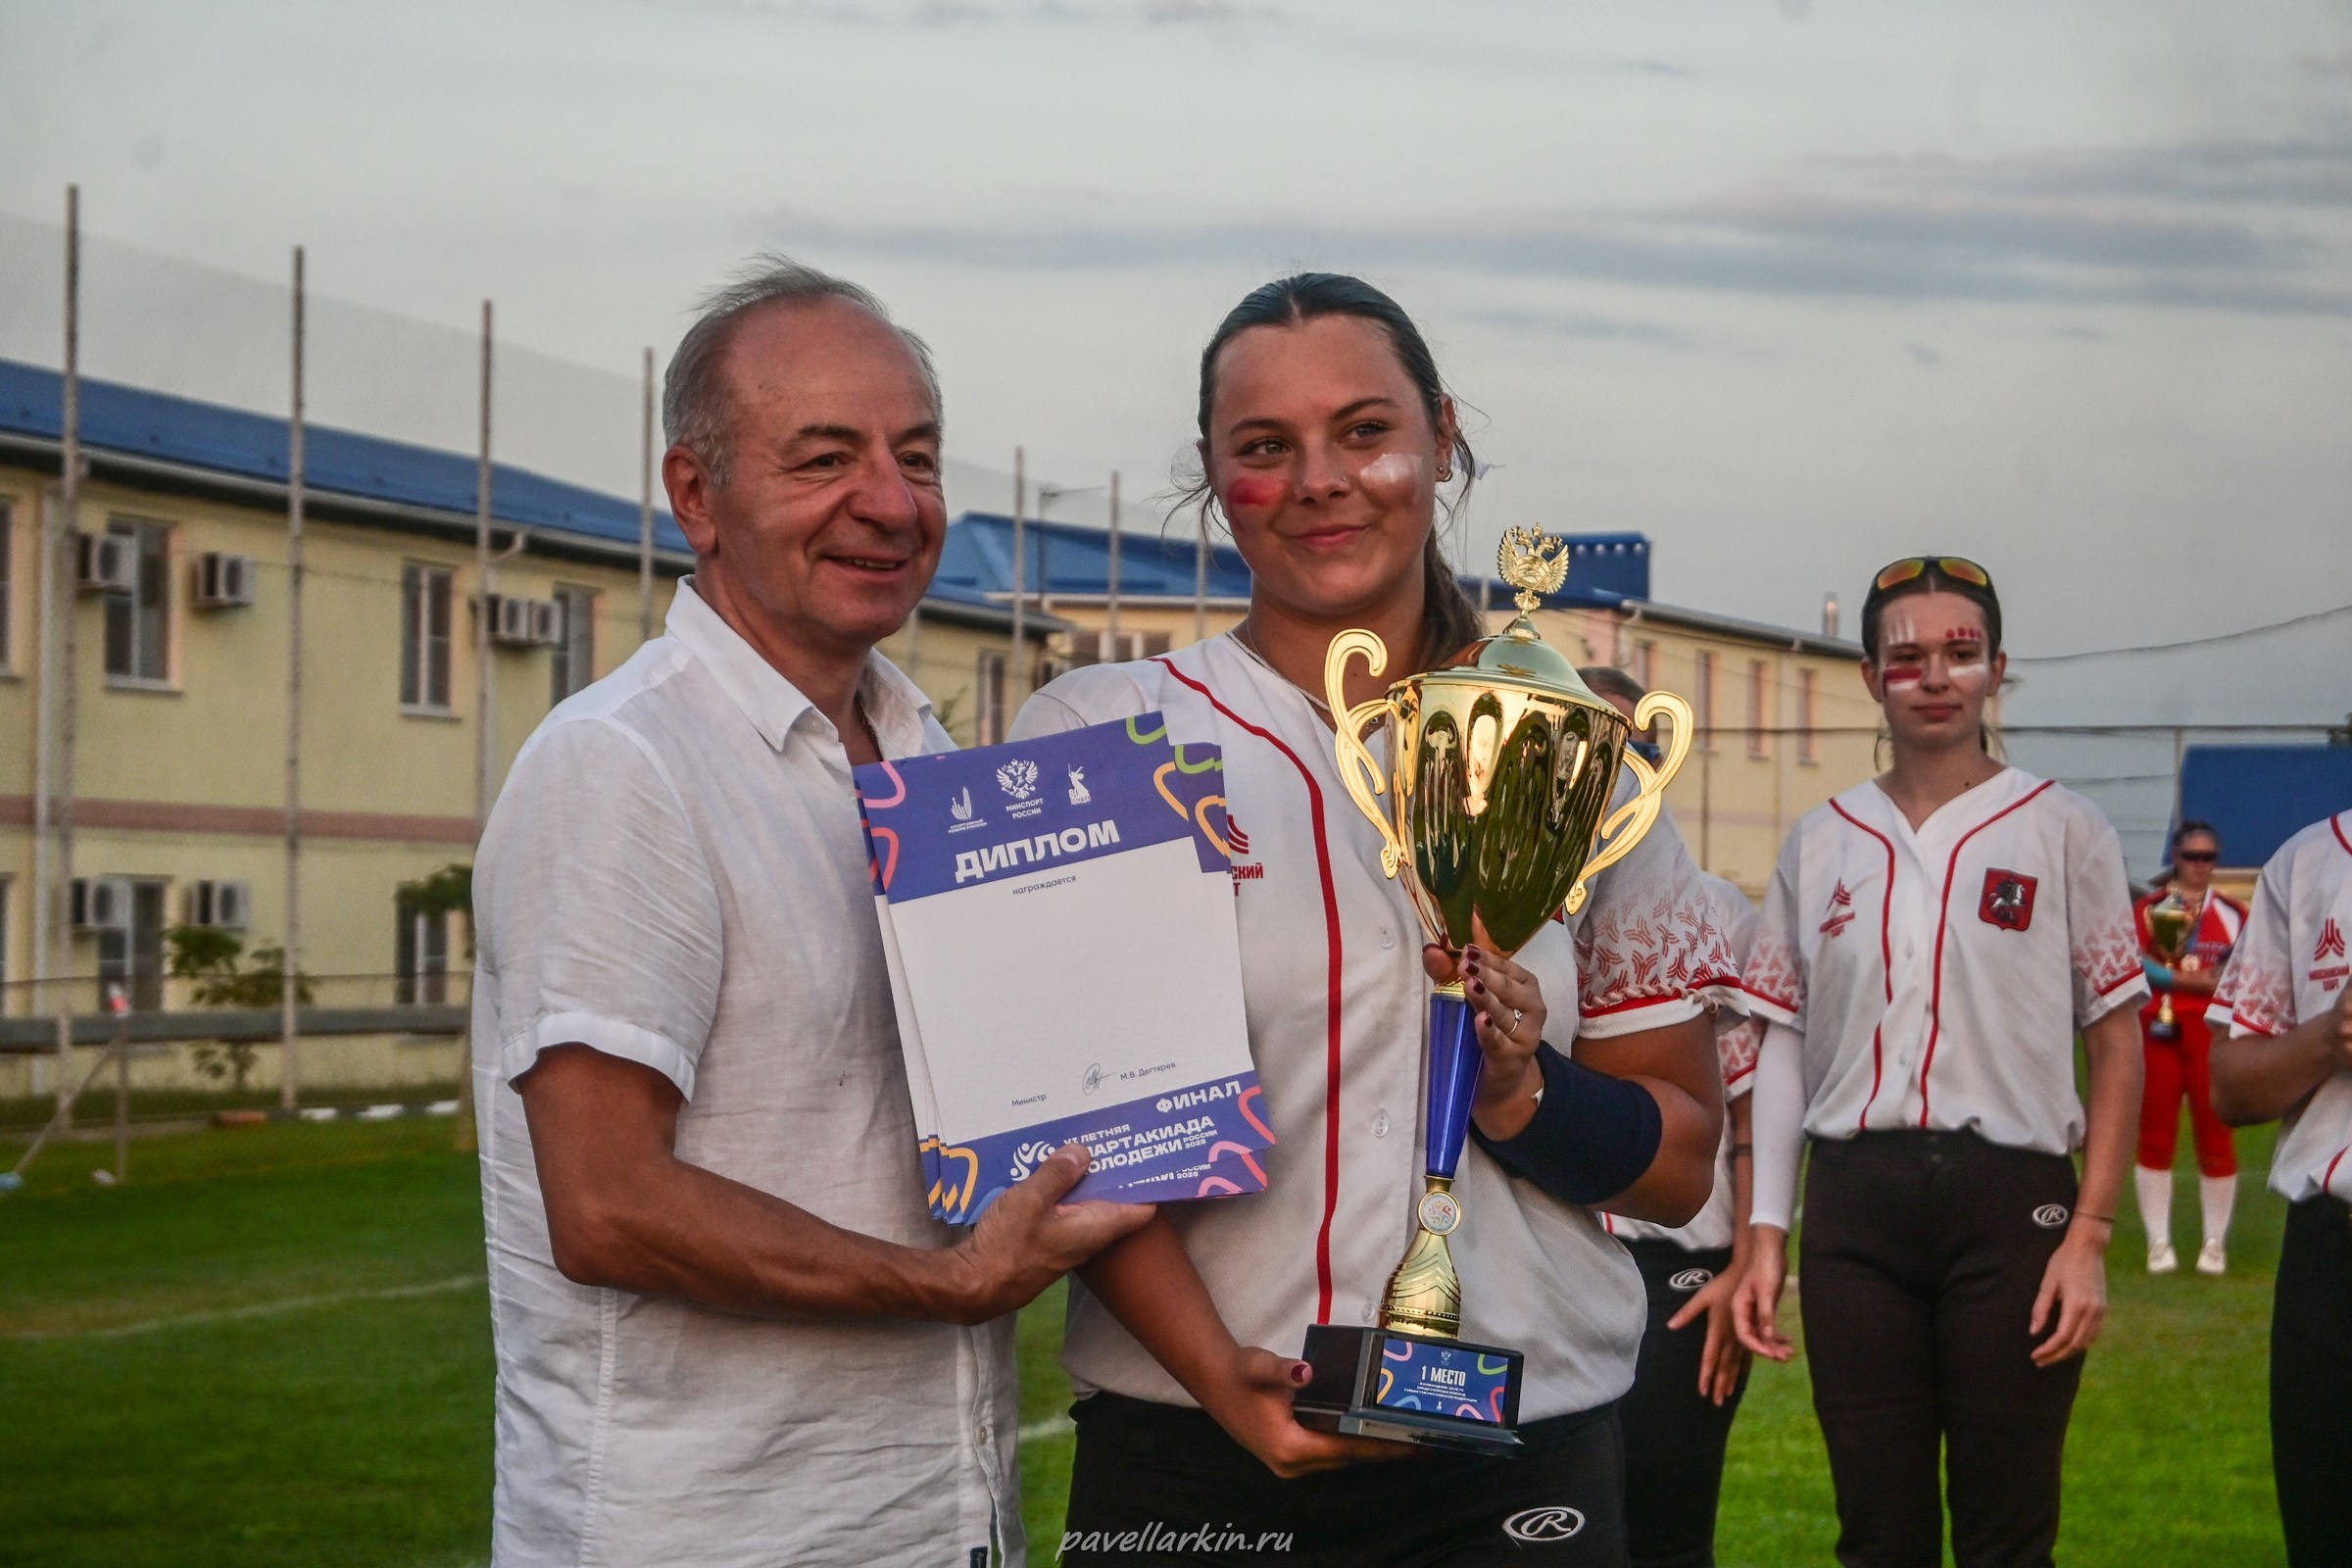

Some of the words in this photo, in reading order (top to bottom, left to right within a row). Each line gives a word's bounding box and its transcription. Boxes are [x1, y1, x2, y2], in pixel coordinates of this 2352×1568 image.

[1005, 798, 1044, 812] МИНСПОРТ
[1012, 807, 1042, 819] РОССИИ
[955, 819, 1120, 883] ДИПЛОМ
[1012, 875, 1077, 895] награждается
[1139, 1062, 1176, 1077] Дегтярев
[1011, 1094, 1047, 1107] Министр
[1155, 1080, 1242, 1112] ФИНАЛ
[1080, 1124, 1131, 1144] ЛЕТНЯЯ
[1088, 1115, 1215, 1158] АРТАКИАДА
[1183, 1129, 1218, 1143] РОССИИ
[1184, 1139, 1206, 1149] 2025
[1085, 1139, 1184, 1174] ОЛОДЕЖИ
[1421, 1365, 1427, 1380] 1
[1431, 1366, 1466, 1387] МЕСТО
